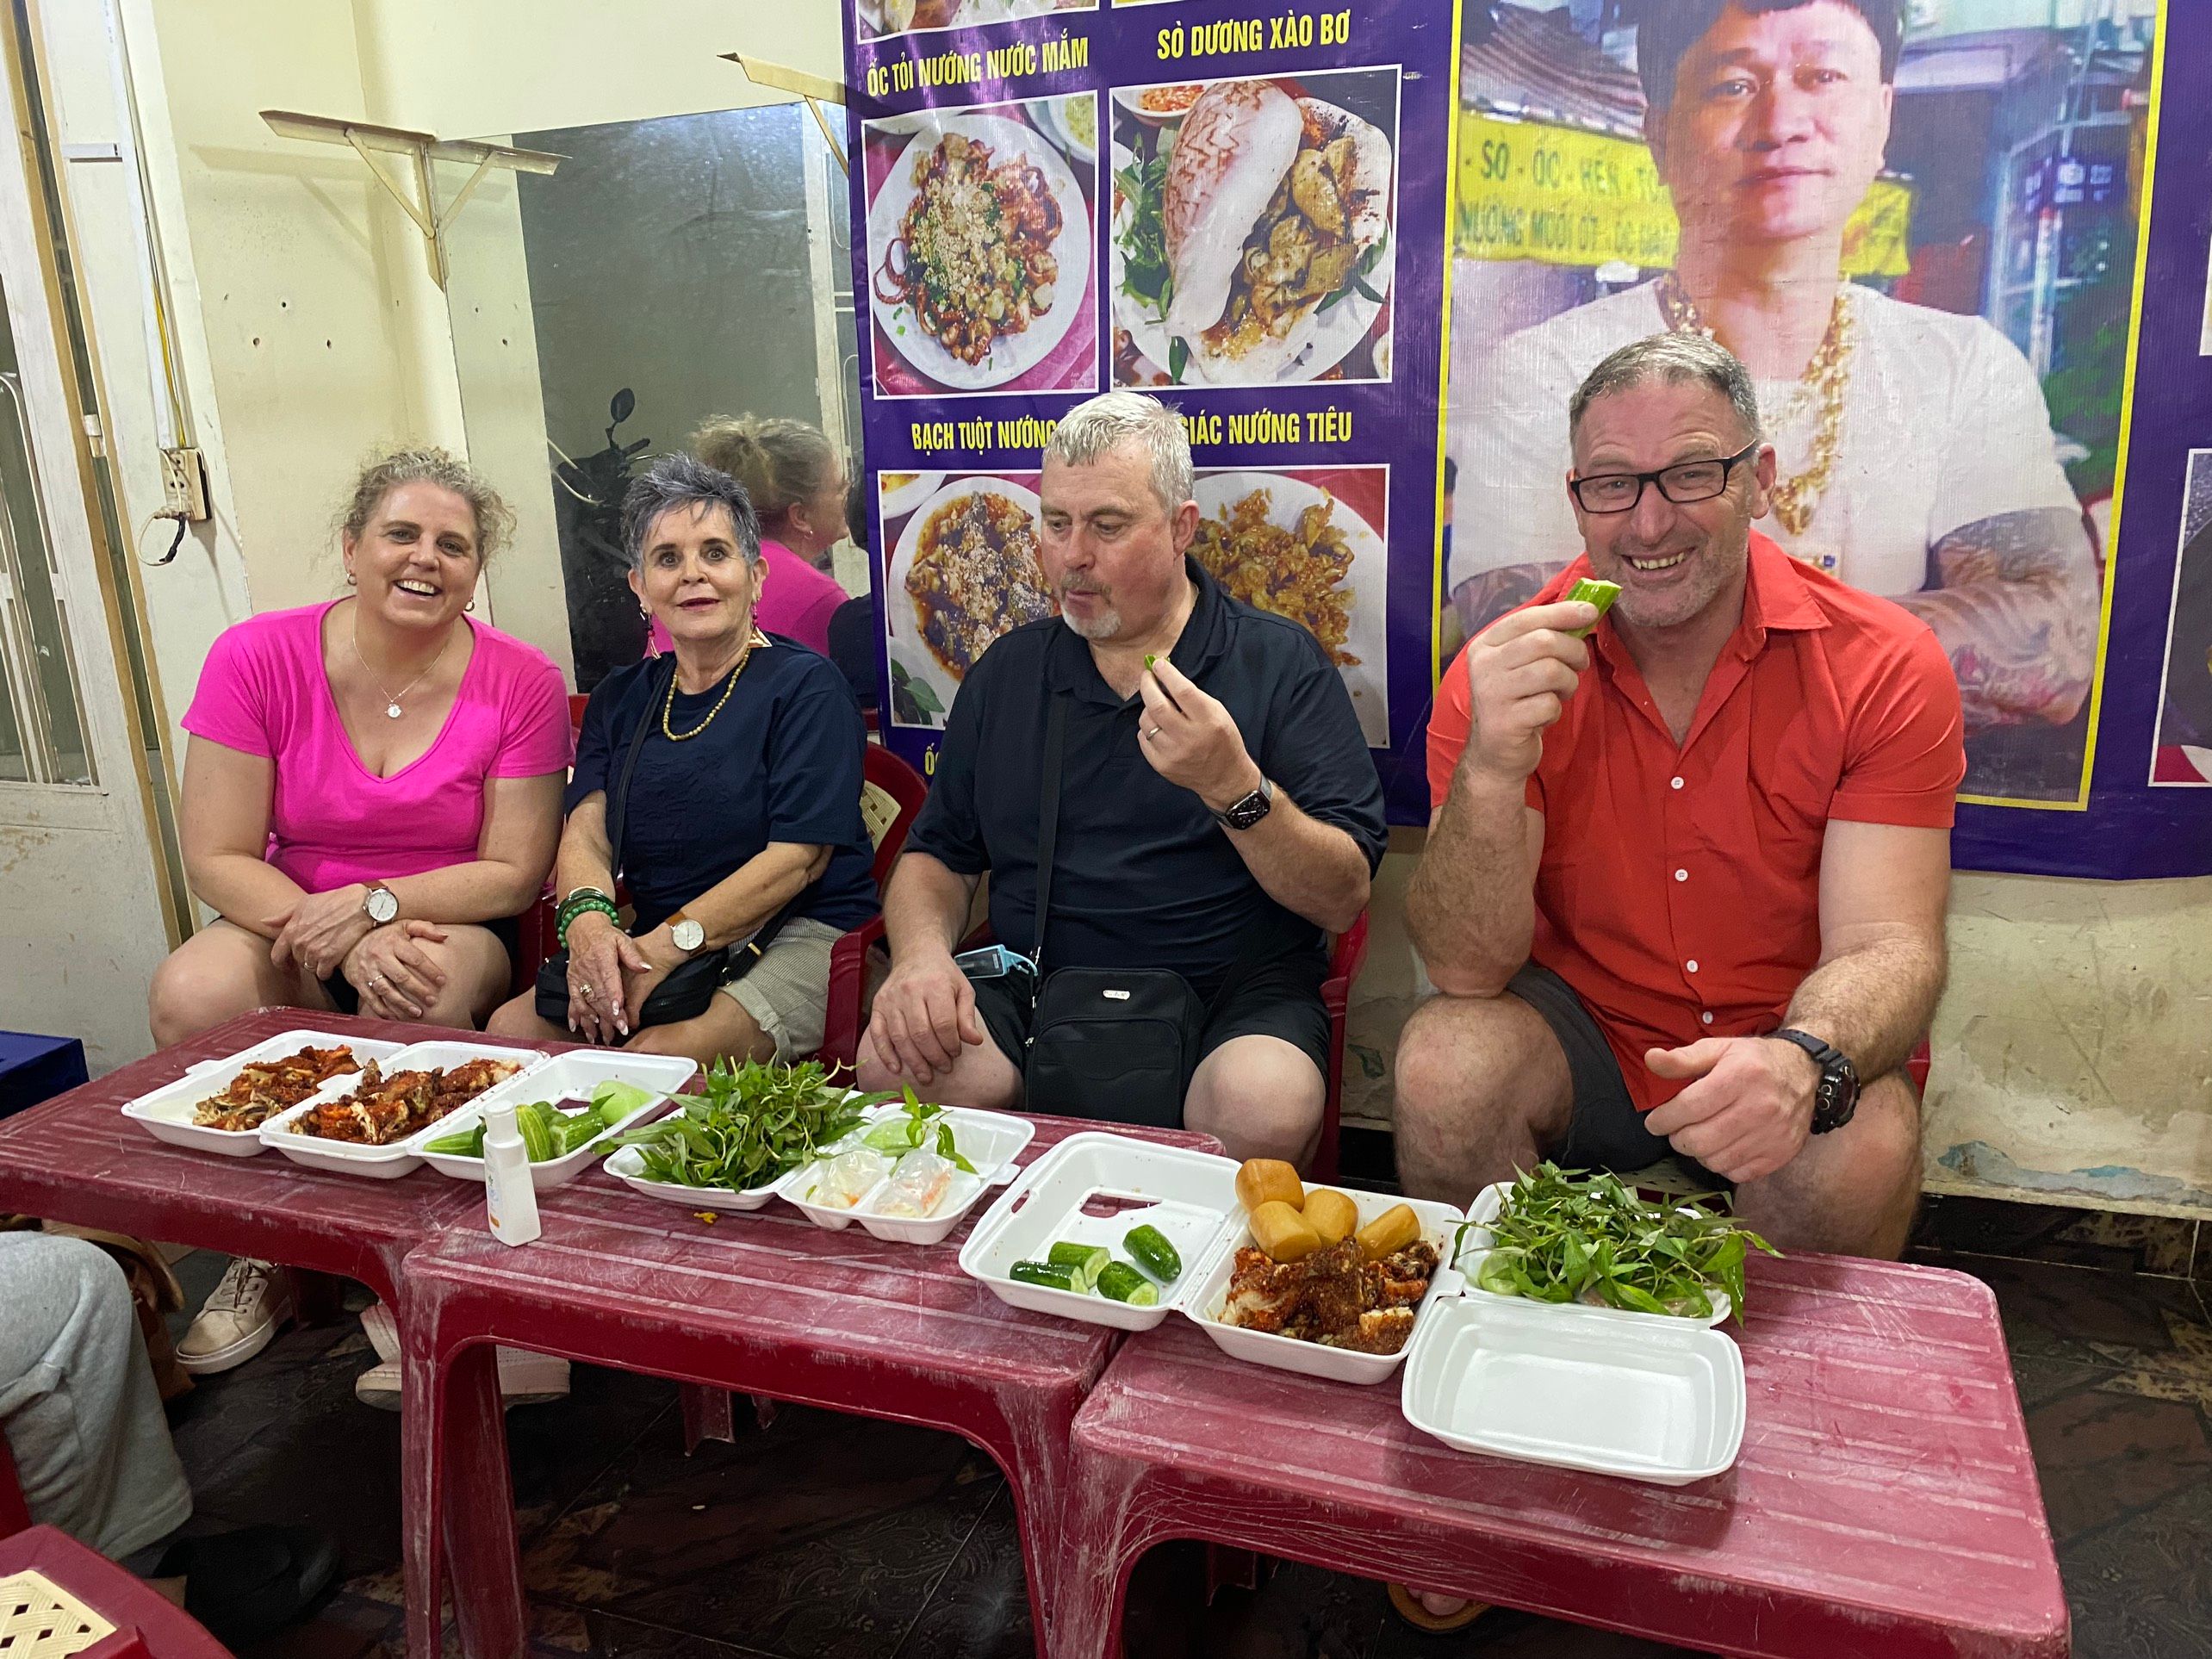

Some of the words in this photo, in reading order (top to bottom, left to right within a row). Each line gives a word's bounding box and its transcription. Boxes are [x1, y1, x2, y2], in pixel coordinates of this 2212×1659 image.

[1157, 20, 1184, 59] SÒ
[1190, 19, 1263, 57] DƯƠNG
[1269, 9, 1313, 50] XÀO
[1320, 9, 1351, 46] BƠ
[867, 58, 890, 97] ỐC
[892, 51, 915, 92] TỎI
[918, 49, 982, 87] NƯỚNG
[986, 40, 1037, 80] NƯỚC
[1042, 28, 1089, 73] MẮM
[911, 422, 954, 457] BẠCH
[958, 416, 993, 456] TUỘT
[1180, 409, 1222, 446] IÁC
[1228, 407, 1300, 444] NƯỚNG
[1307, 406, 1352, 442] TIÊU
[924, 743, 939, 775] Ố
